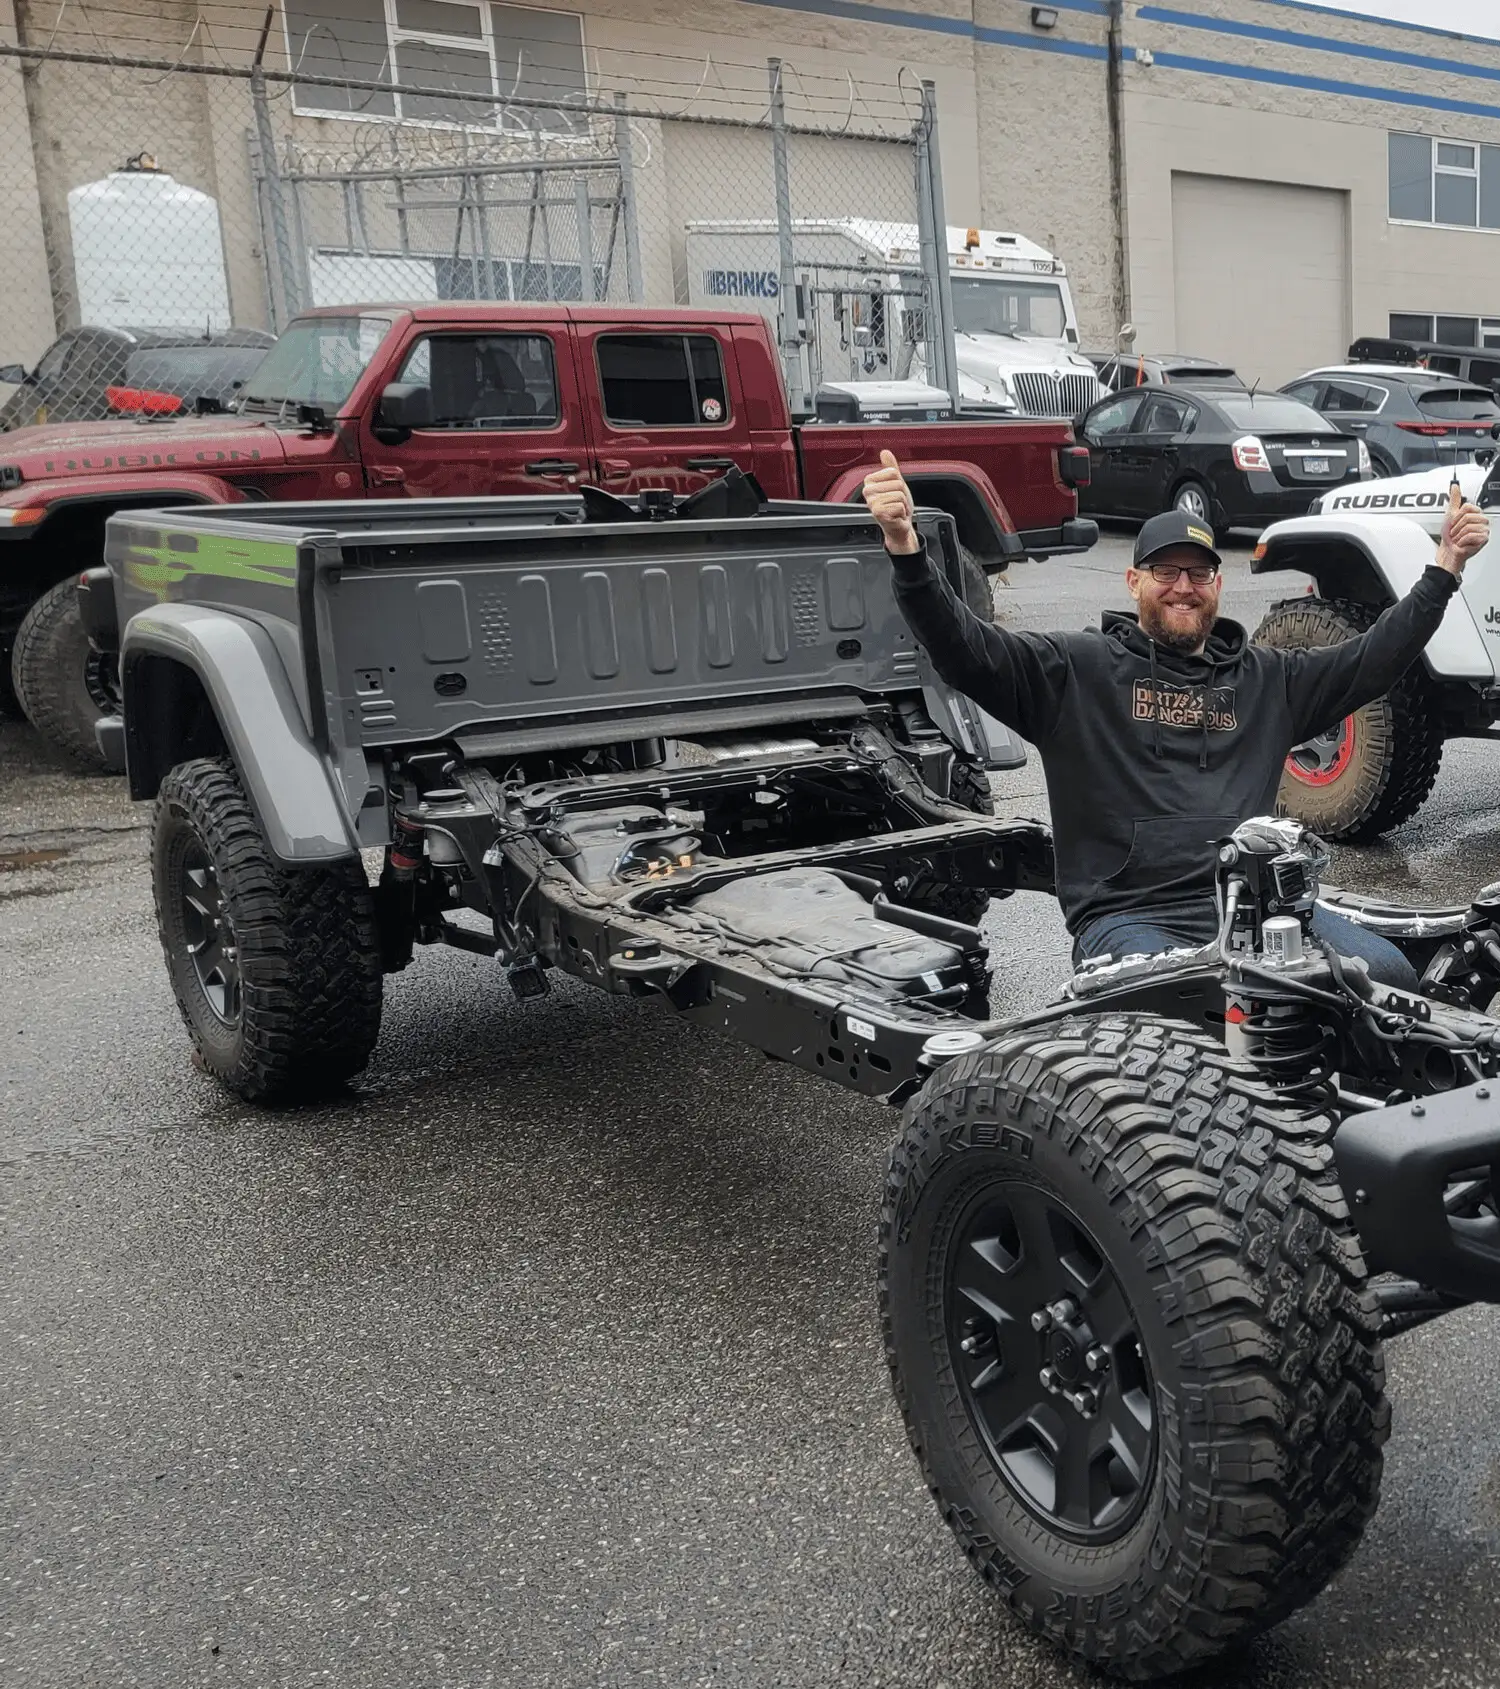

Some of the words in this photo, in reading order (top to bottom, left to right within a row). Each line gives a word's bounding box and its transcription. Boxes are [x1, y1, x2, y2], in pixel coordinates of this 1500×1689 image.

[715, 270, 779, 297] BRINKS
[45, 449, 262, 472] RUBICON
[1136, 688, 1183, 708] DIRTY
[1136, 702, 1234, 728] DANGEROUS
